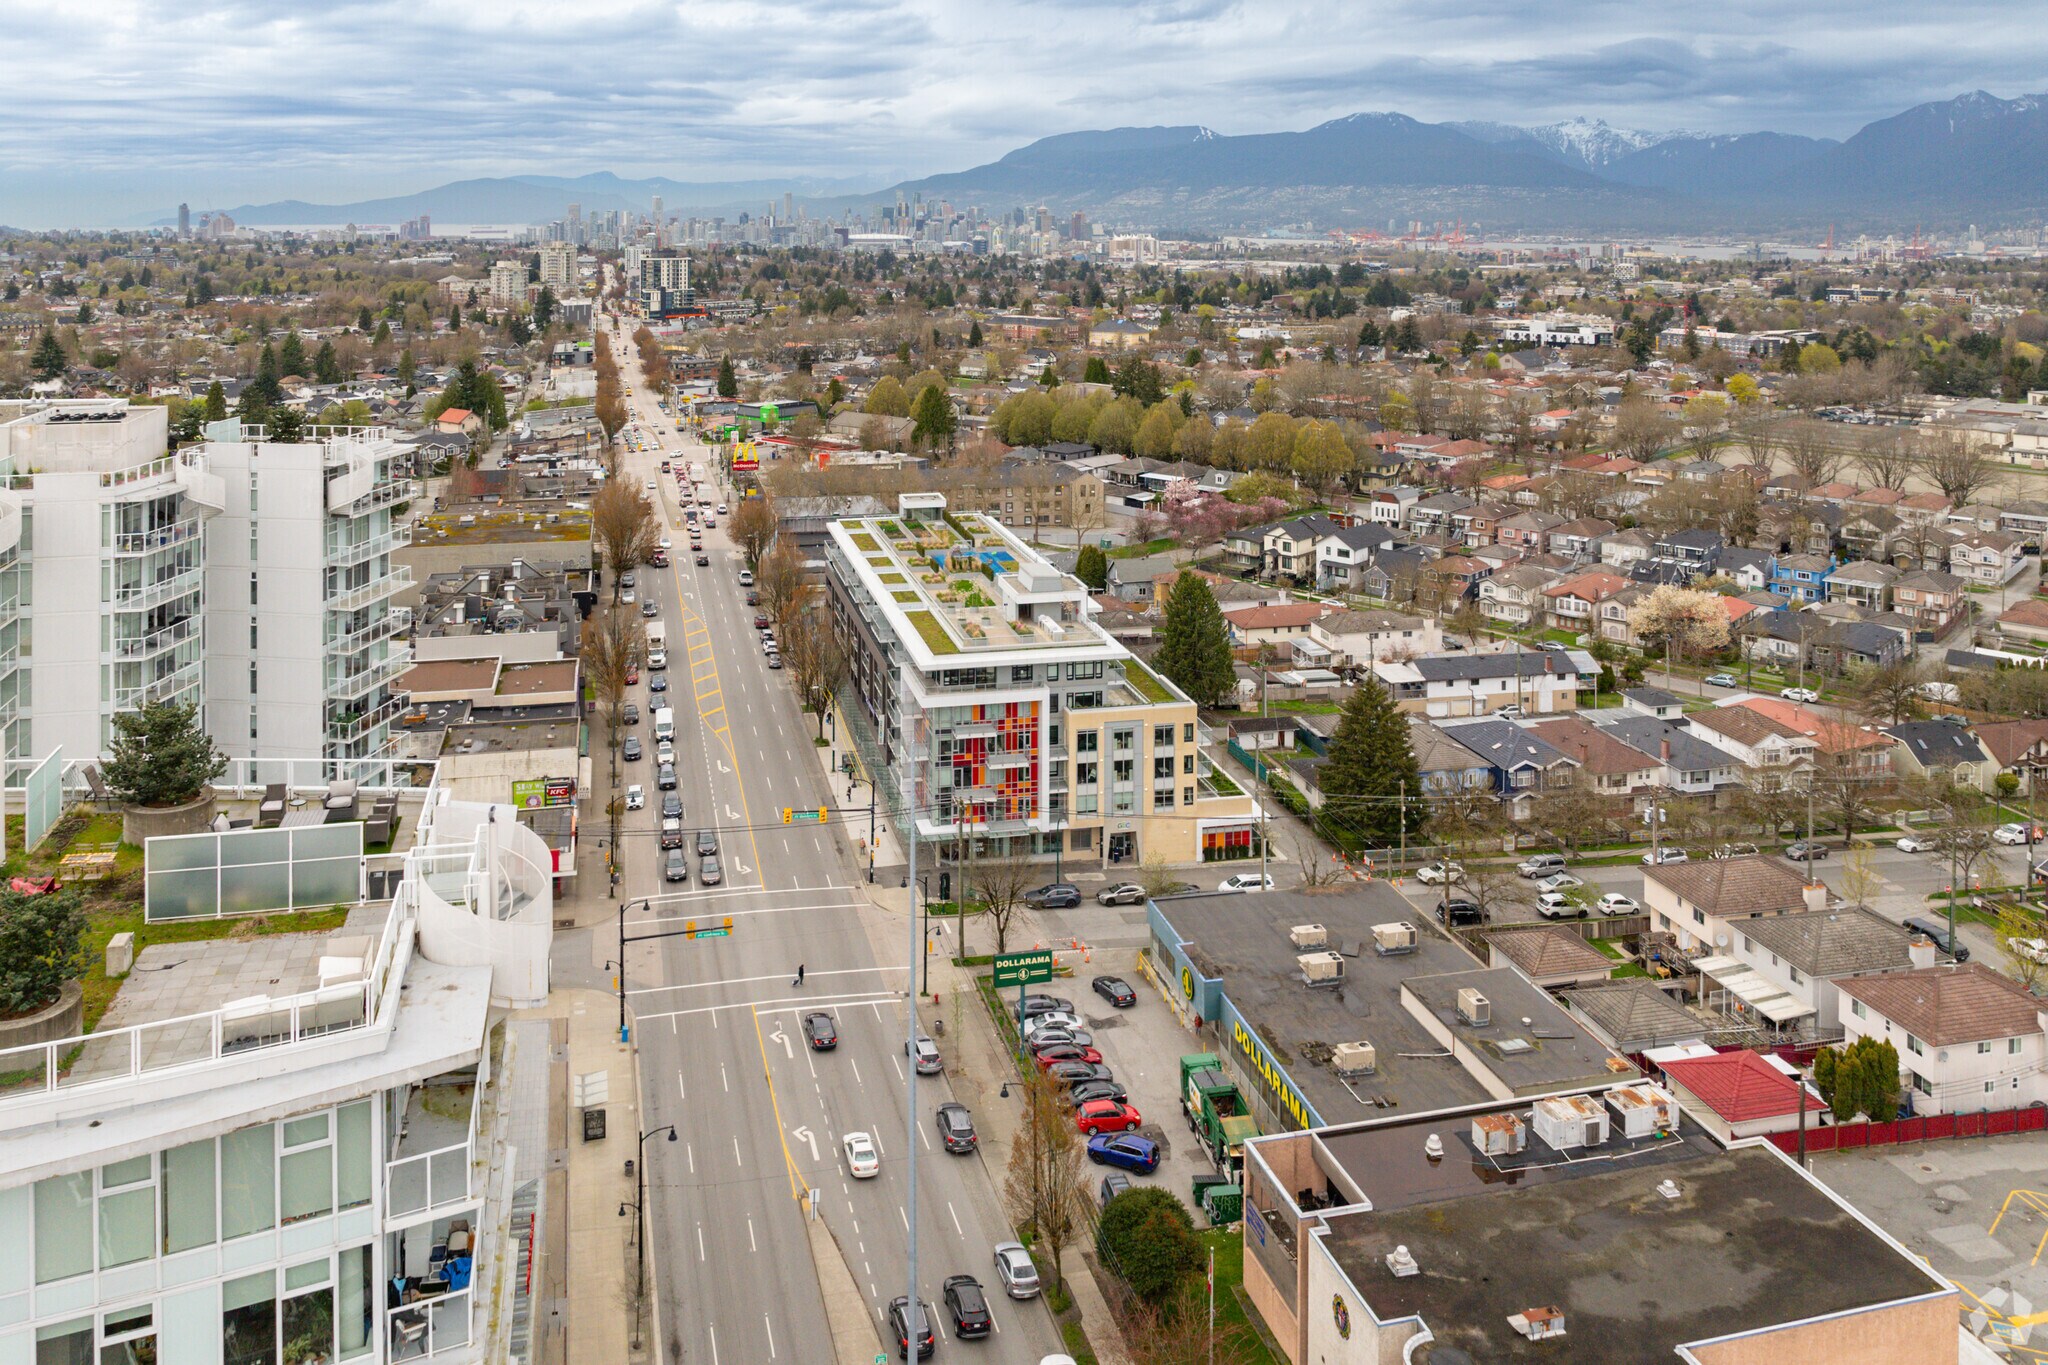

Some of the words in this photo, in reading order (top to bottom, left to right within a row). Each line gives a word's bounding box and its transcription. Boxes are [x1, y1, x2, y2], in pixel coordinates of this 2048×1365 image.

[550, 788, 566, 796] KFC
[996, 955, 1051, 969] DOLLARAMA
[1234, 1021, 1310, 1131] DOLLARAMA
